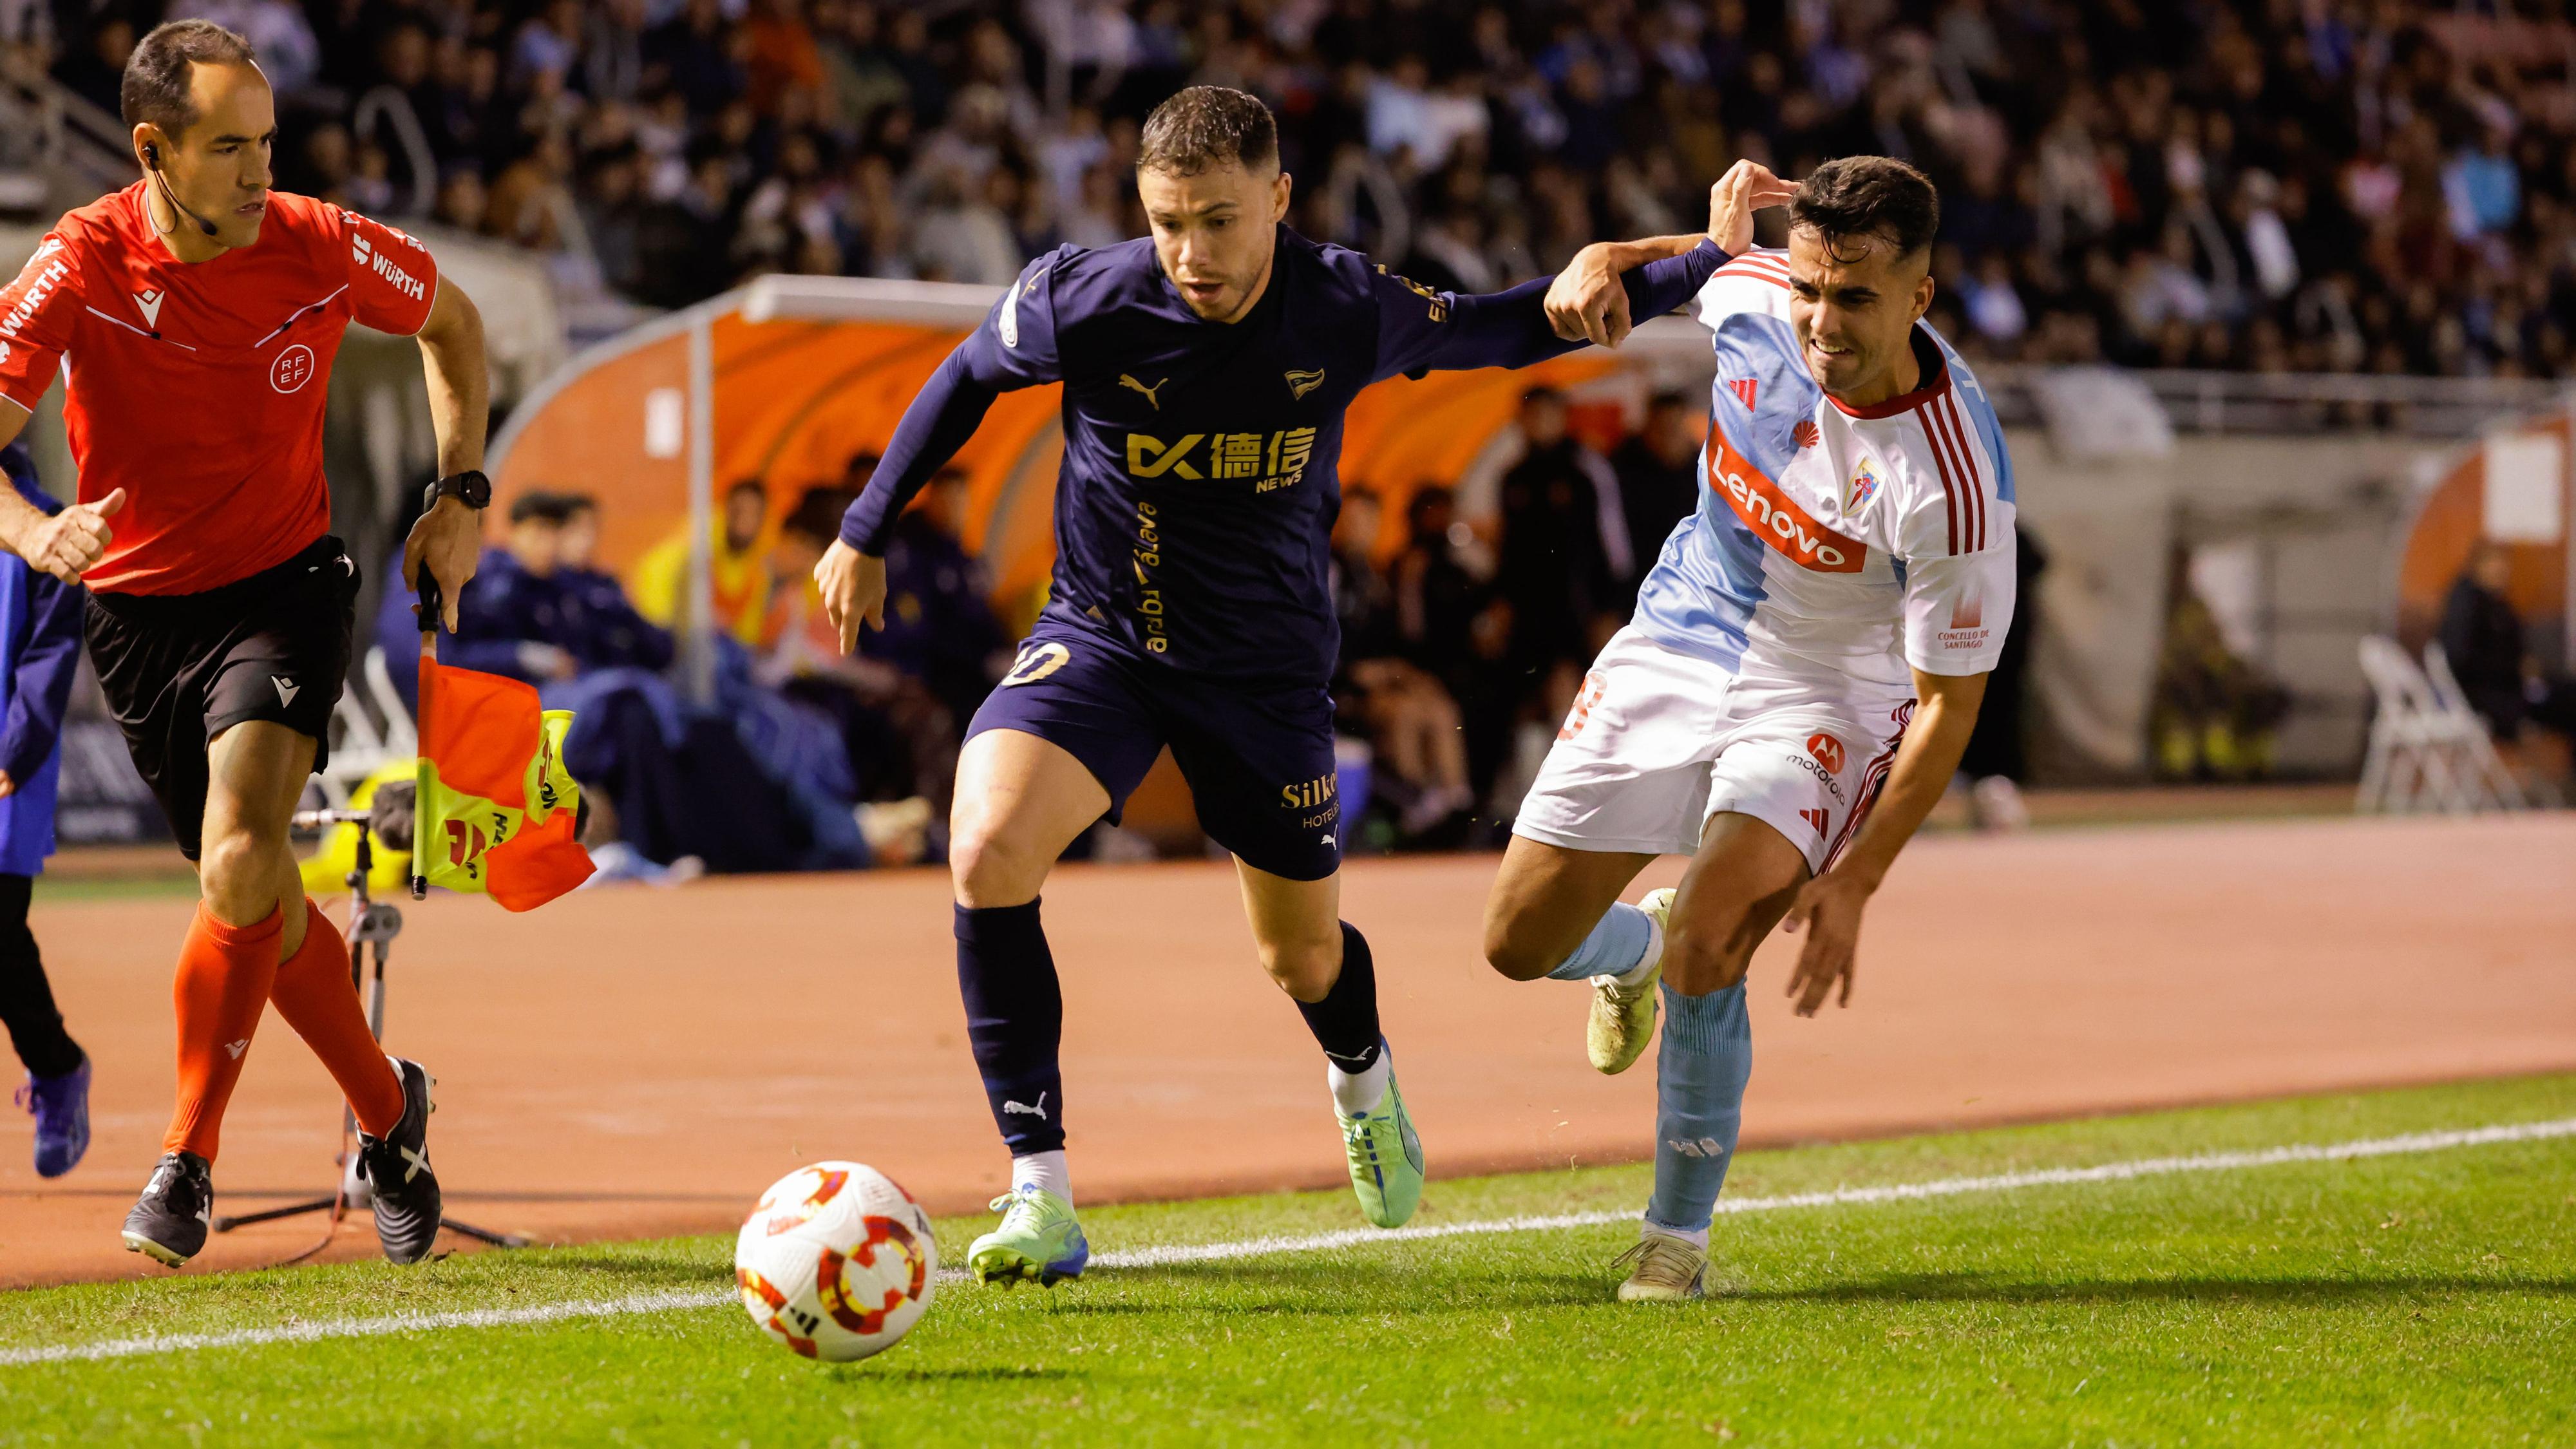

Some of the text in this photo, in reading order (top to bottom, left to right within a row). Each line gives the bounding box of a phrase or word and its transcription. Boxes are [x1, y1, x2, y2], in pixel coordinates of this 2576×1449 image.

[0, 260, 68, 337] WÜRTH
[373, 251, 424, 301] WÜRTH
[1209, 428, 1316, 480] 德信
[1256, 471, 1303, 494] NEWS
[1712, 444, 1845, 567] Lenovo
[1938, 629, 1989, 640] CONCELLO DE
[1944, 639, 1983, 650] SANTIAGO
[1786, 755, 1845, 807] motorola
